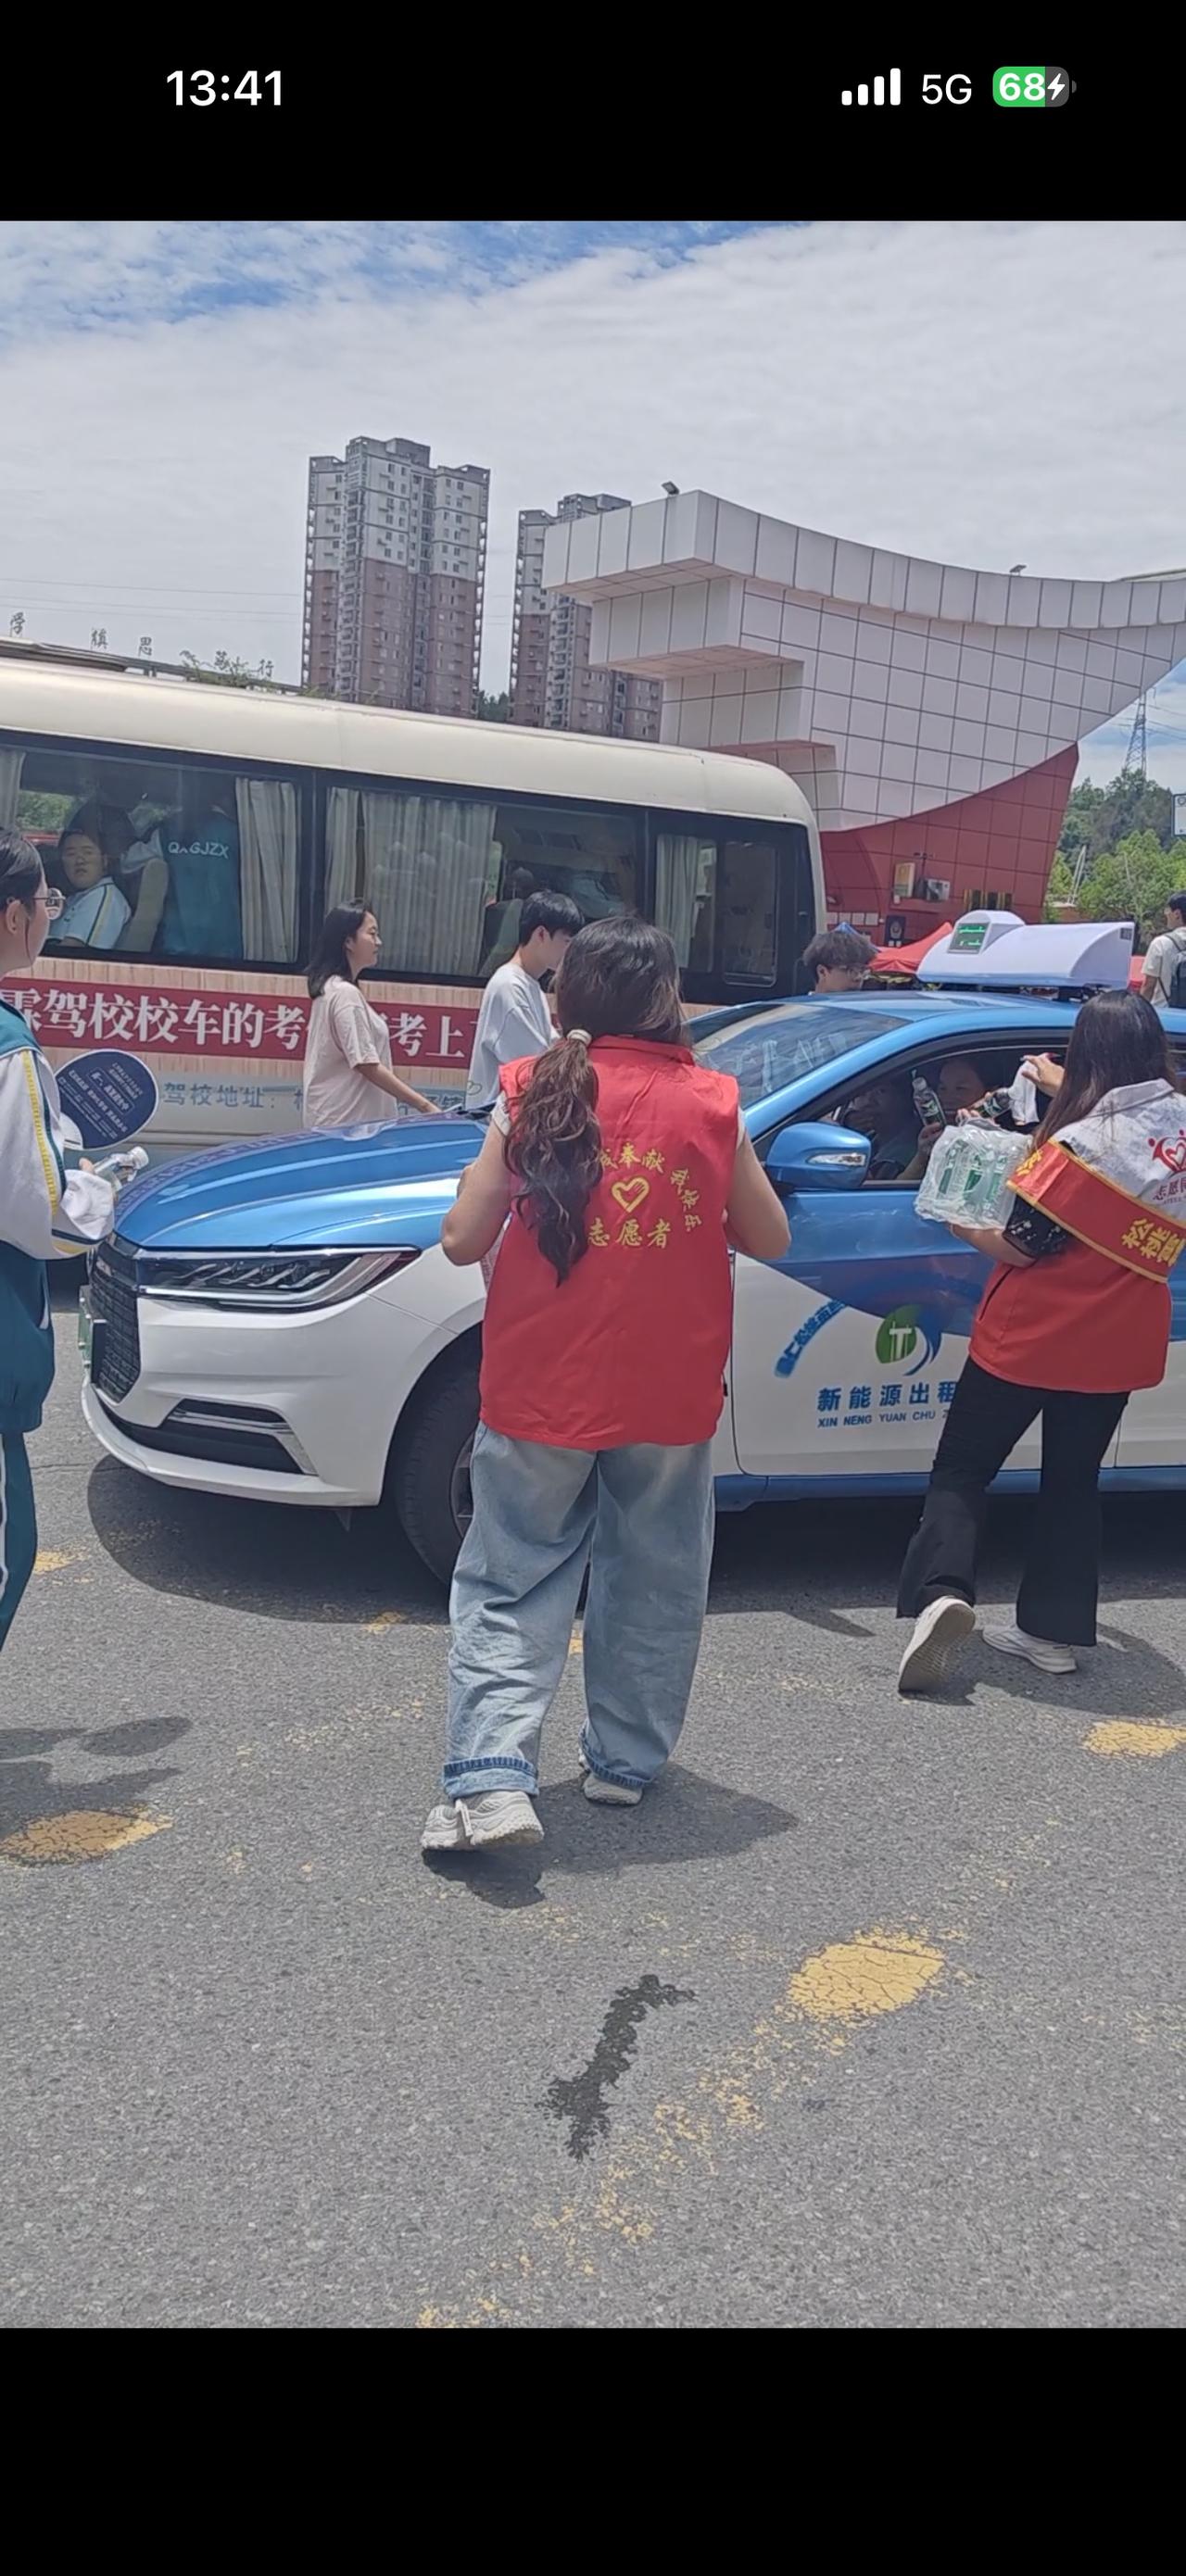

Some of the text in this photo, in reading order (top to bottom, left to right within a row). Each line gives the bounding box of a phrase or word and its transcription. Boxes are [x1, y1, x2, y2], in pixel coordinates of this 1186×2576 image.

[587, 1217, 671, 1249] 志愿者
[816, 1380, 958, 1413] 新能源出租
[817, 1416, 838, 1428] XIN
[843, 1414, 872, 1426] NENG
[879, 1412, 907, 1423] YUAN
[912, 1410, 936, 1421] CHU
